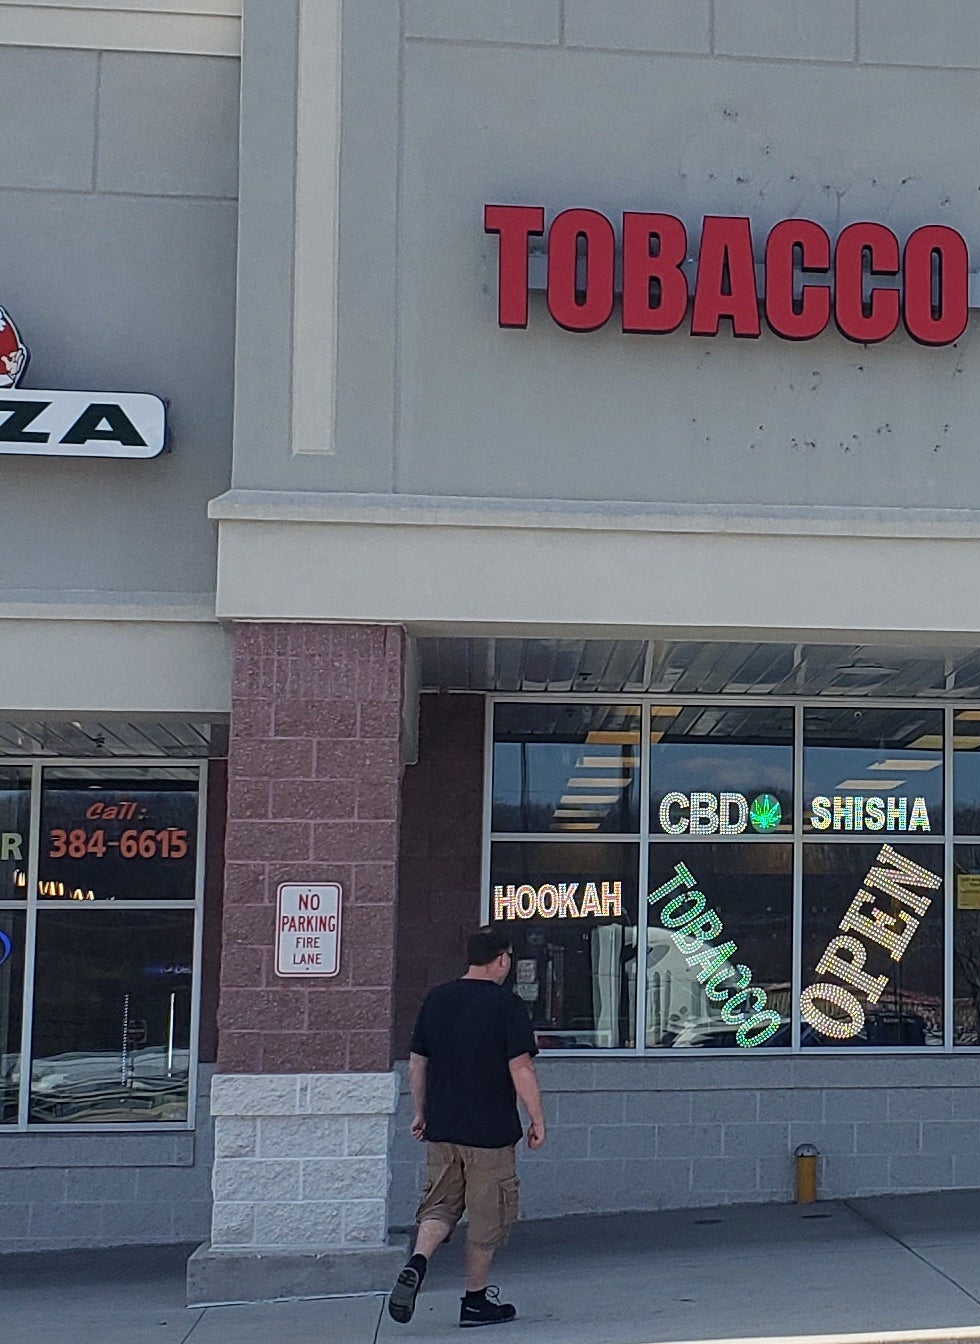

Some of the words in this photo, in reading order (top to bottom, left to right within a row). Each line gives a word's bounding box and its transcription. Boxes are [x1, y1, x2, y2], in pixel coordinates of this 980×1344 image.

[484, 203, 969, 347] TOBACCO
[658, 792, 749, 835] CBD
[810, 796, 931, 832] SHISHA
[49, 829, 188, 859] 384-6615
[298, 894, 320, 911] NO
[493, 881, 622, 921] HOOKAH
[281, 916, 336, 932] PARKING
[799, 843, 943, 1040] OPEN
[293, 953, 323, 965] LANE
[295, 937, 321, 949] FIRE
[647, 861, 782, 1048] TOBACCO
